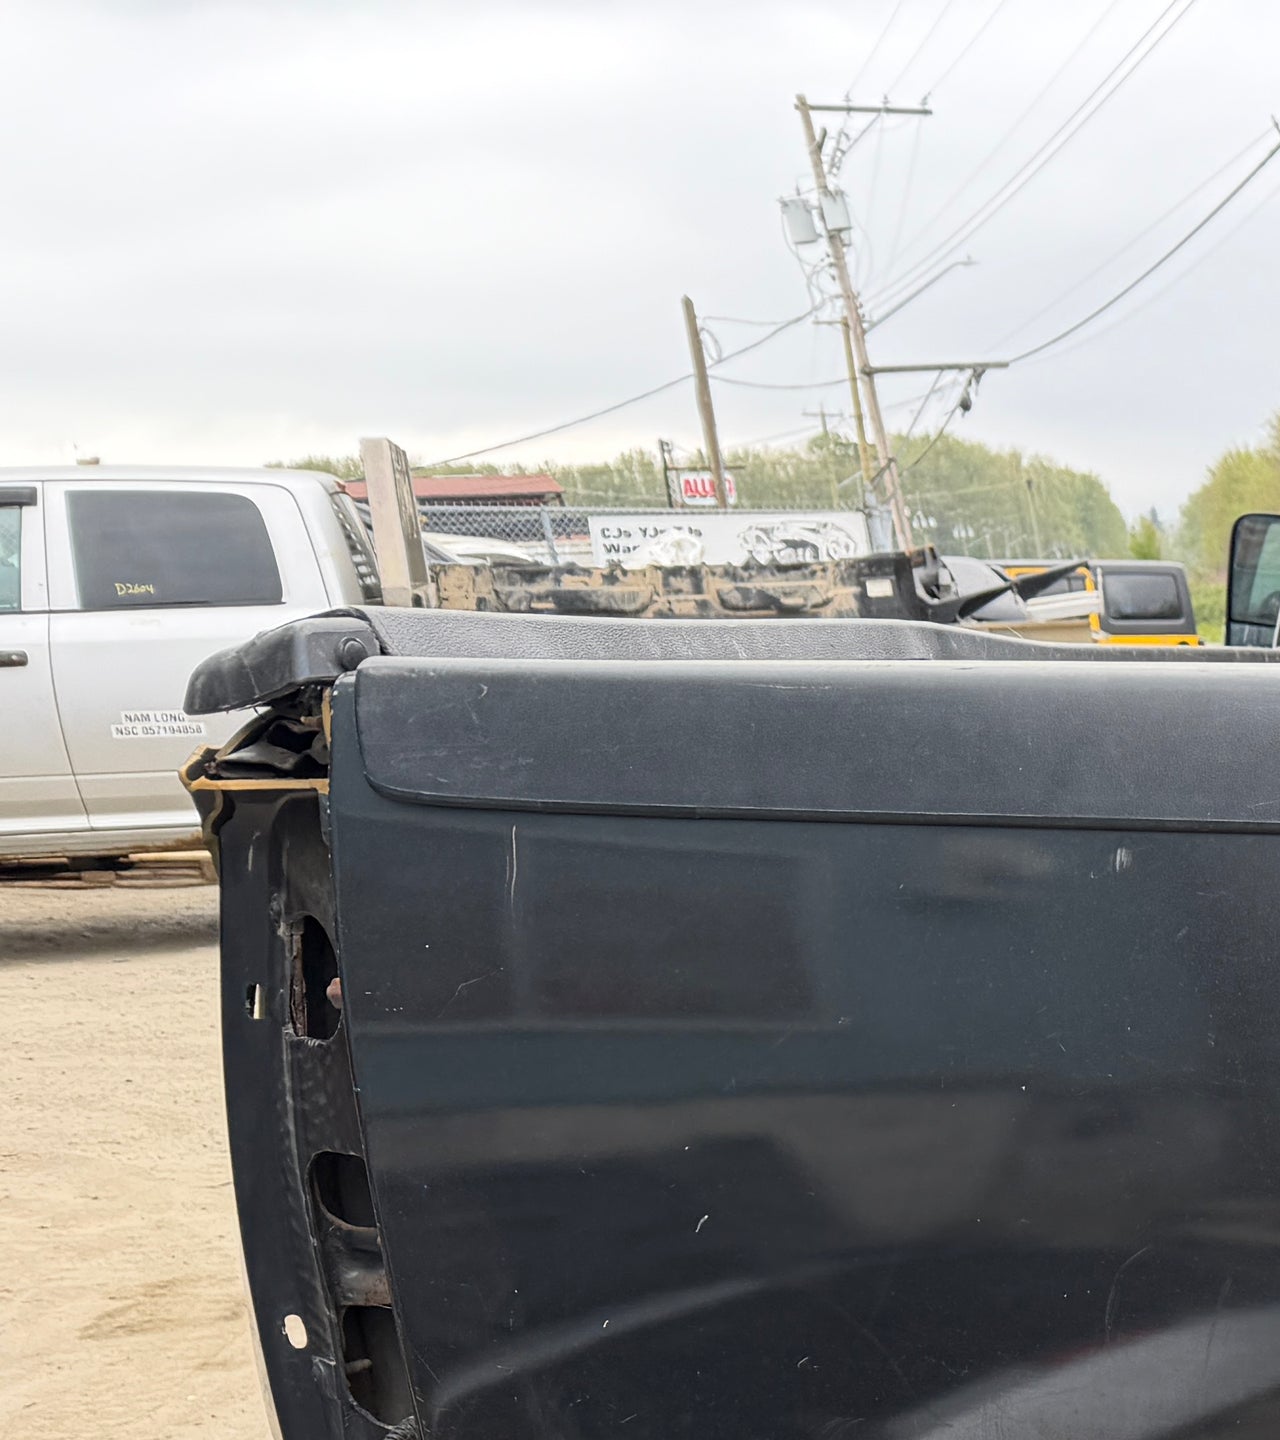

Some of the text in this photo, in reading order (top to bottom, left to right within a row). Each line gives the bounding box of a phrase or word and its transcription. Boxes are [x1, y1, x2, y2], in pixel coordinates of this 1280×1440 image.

[114, 582, 155, 596] D2604
[124, 712, 186, 723] NAM LONG
[116, 726, 139, 736] NSC
